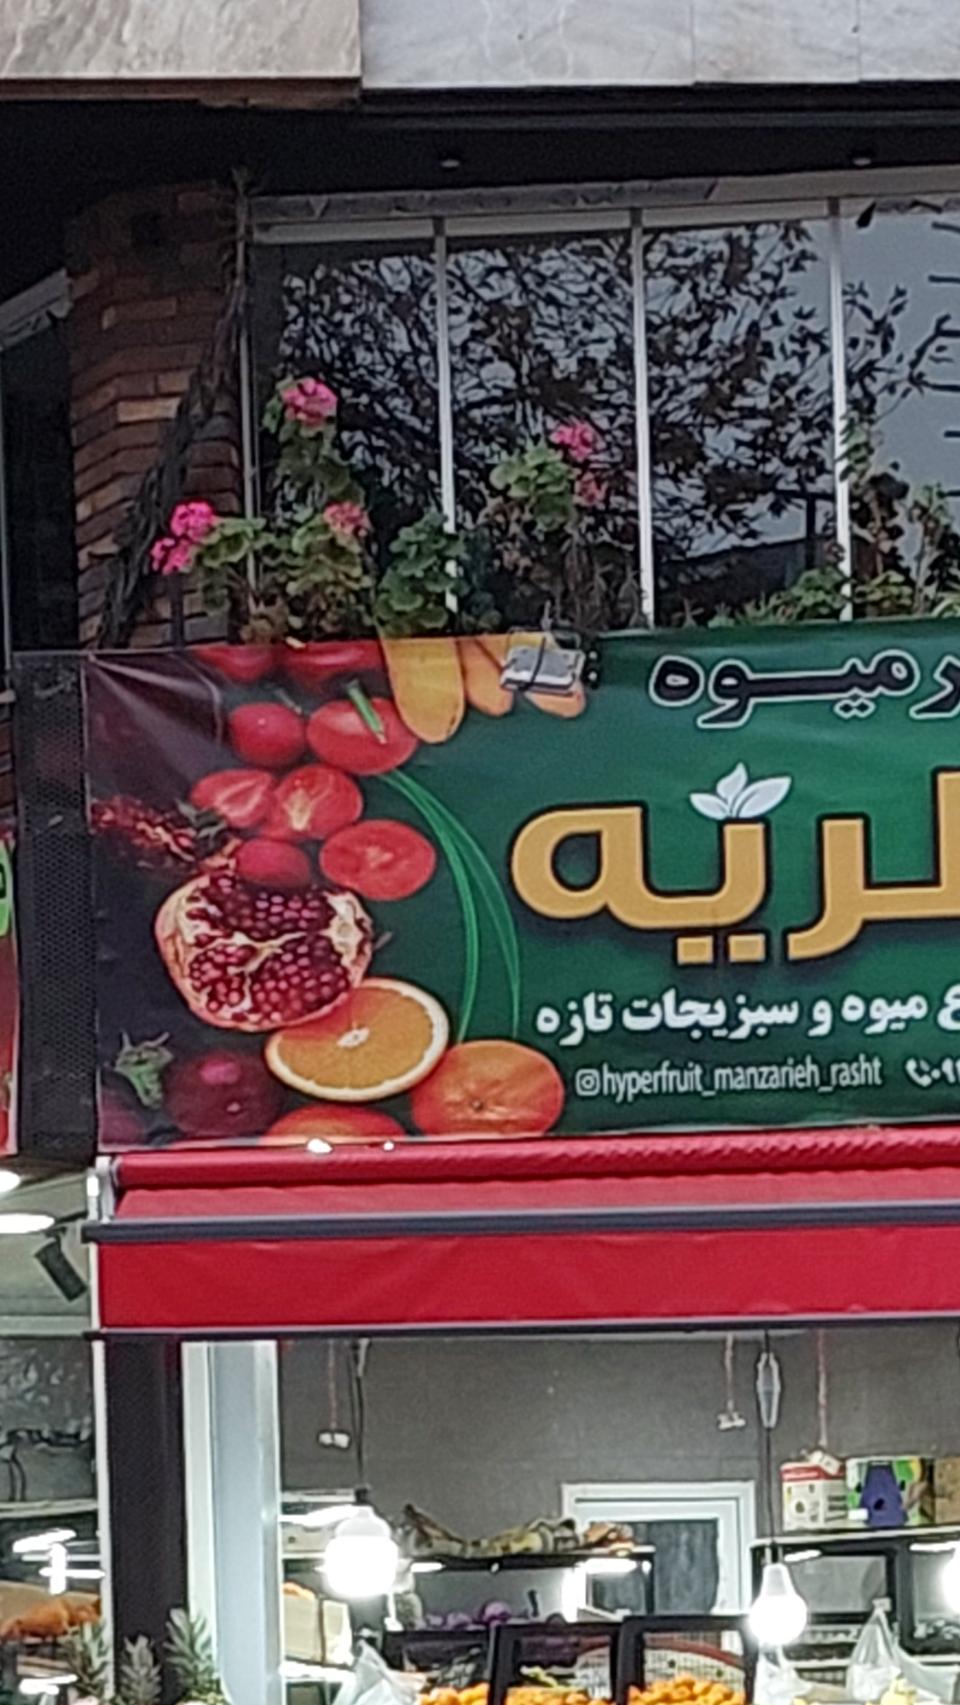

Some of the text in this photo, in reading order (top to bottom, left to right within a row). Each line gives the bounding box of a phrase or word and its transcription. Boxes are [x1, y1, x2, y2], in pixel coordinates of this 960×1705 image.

[649, 649, 921, 729] میوه
[536, 991, 613, 1046] تازه
[622, 988, 800, 1039] سبزیجات
[807, 999, 833, 1037] و
[841, 993, 928, 1034] میوه
[602, 1054, 883, 1102] hyperfruit_manzarieh_rasht
